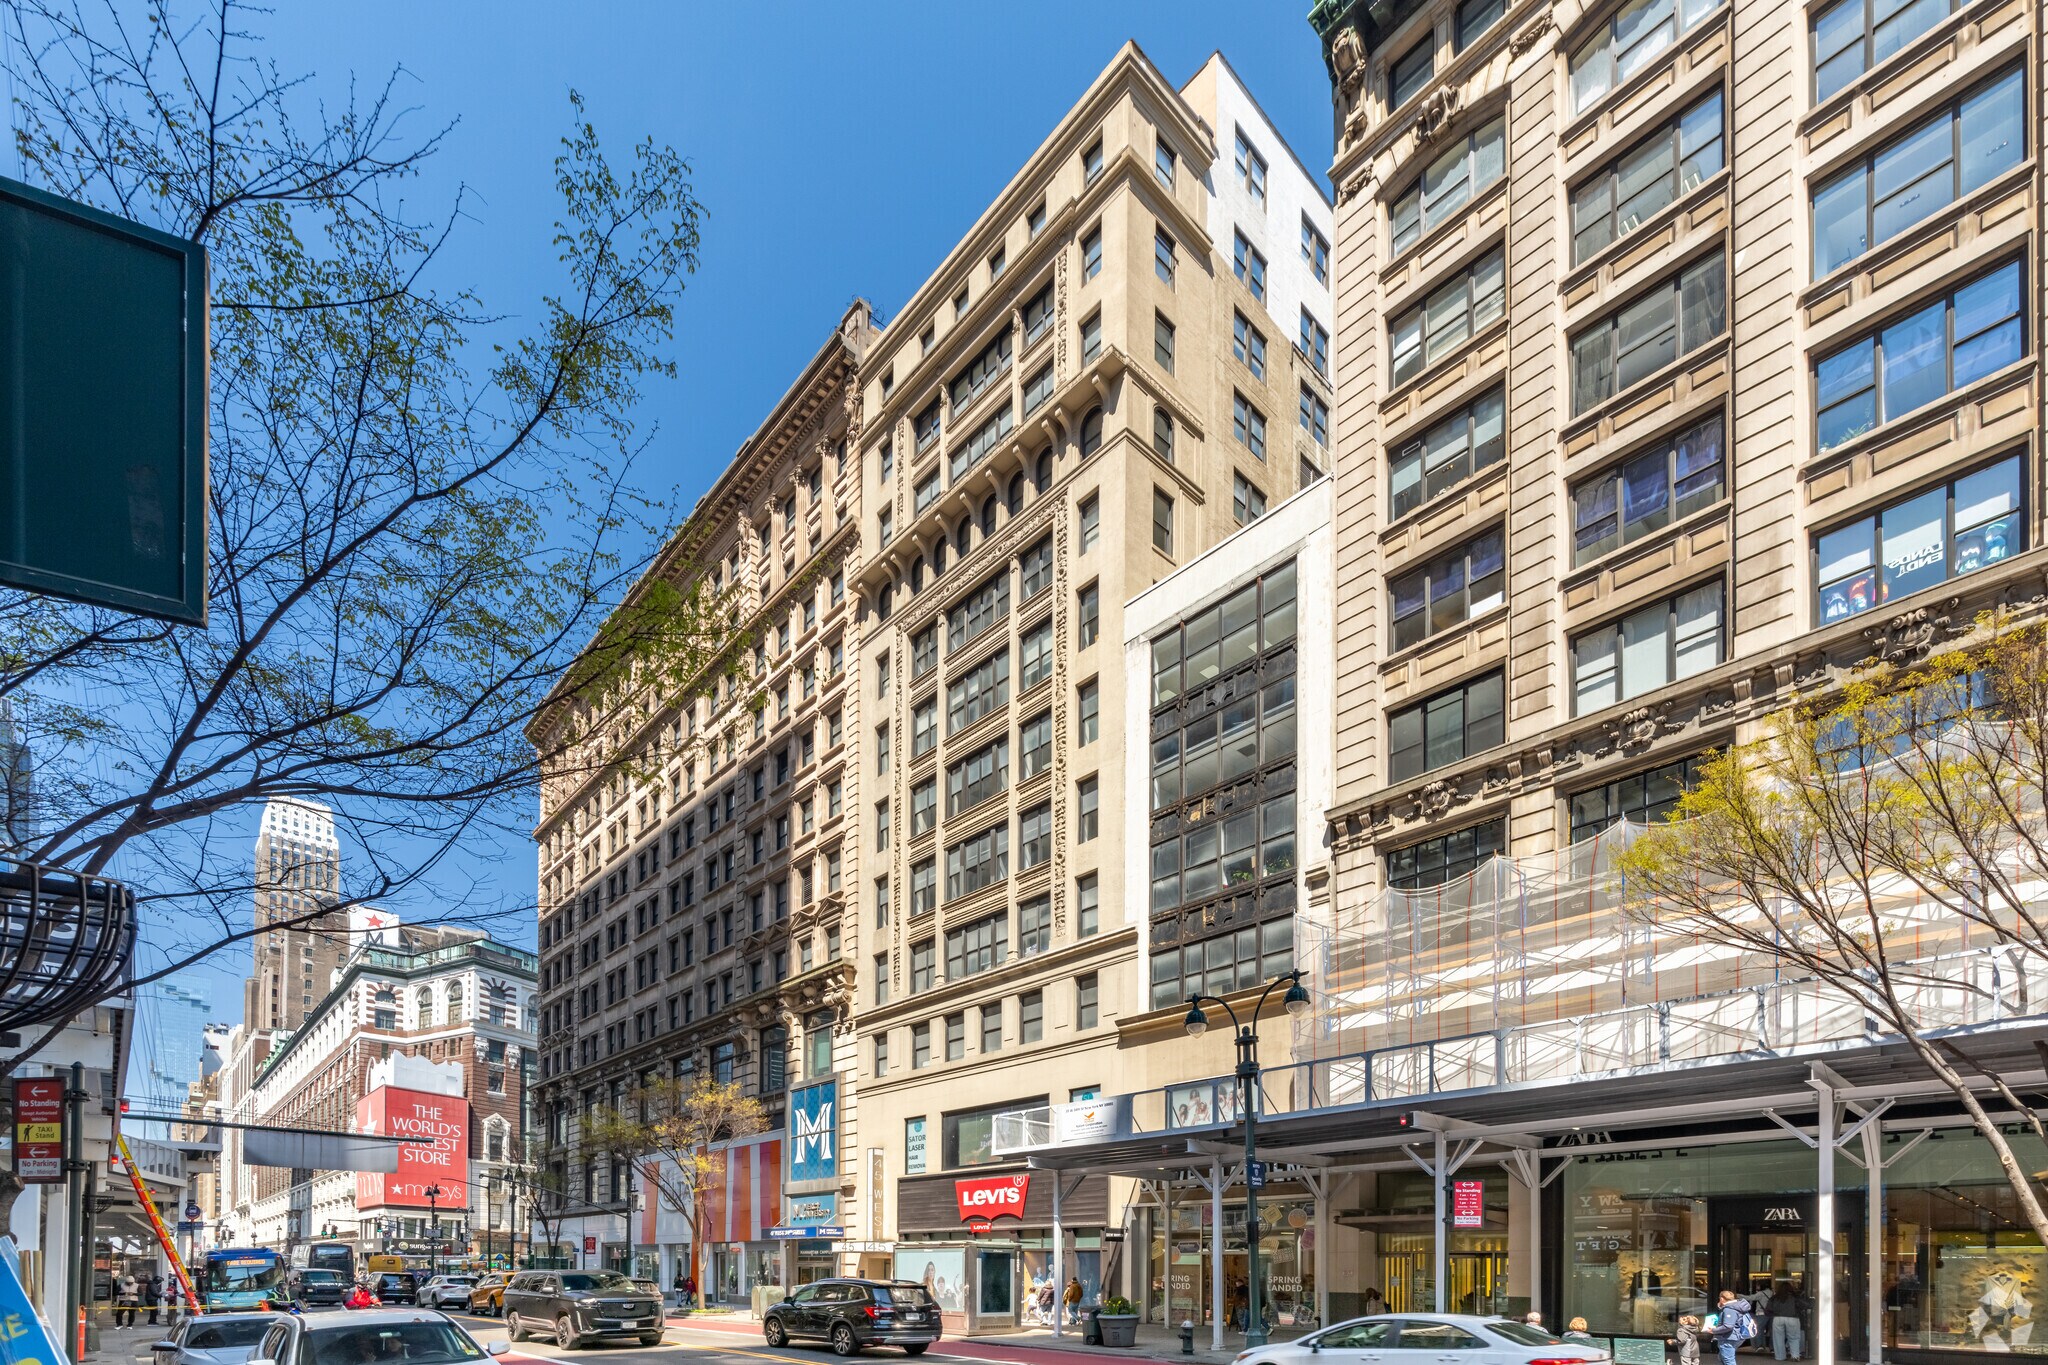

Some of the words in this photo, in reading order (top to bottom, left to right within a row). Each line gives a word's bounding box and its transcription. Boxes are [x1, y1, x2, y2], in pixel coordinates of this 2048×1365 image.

[30, 1100, 60, 1108] Standing
[413, 1104, 443, 1121] THE
[392, 1116, 462, 1138] WORLD'S
[393, 1132, 460, 1152] ARGEST
[908, 1143, 925, 1152] LASER
[404, 1148, 451, 1166] STORE
[32, 1160, 58, 1168] Parking
[1764, 1207, 1802, 1221] ZARA
[842, 1244, 855, 1253] 45
[867, 1243, 887, 1252] 45
[1162, 1274, 1190, 1282] SRING
[1267, 1275, 1302, 1284] SPRING
[1161, 1282, 1191, 1290] LNDED
[1266, 1284, 1303, 1292] LANDED
